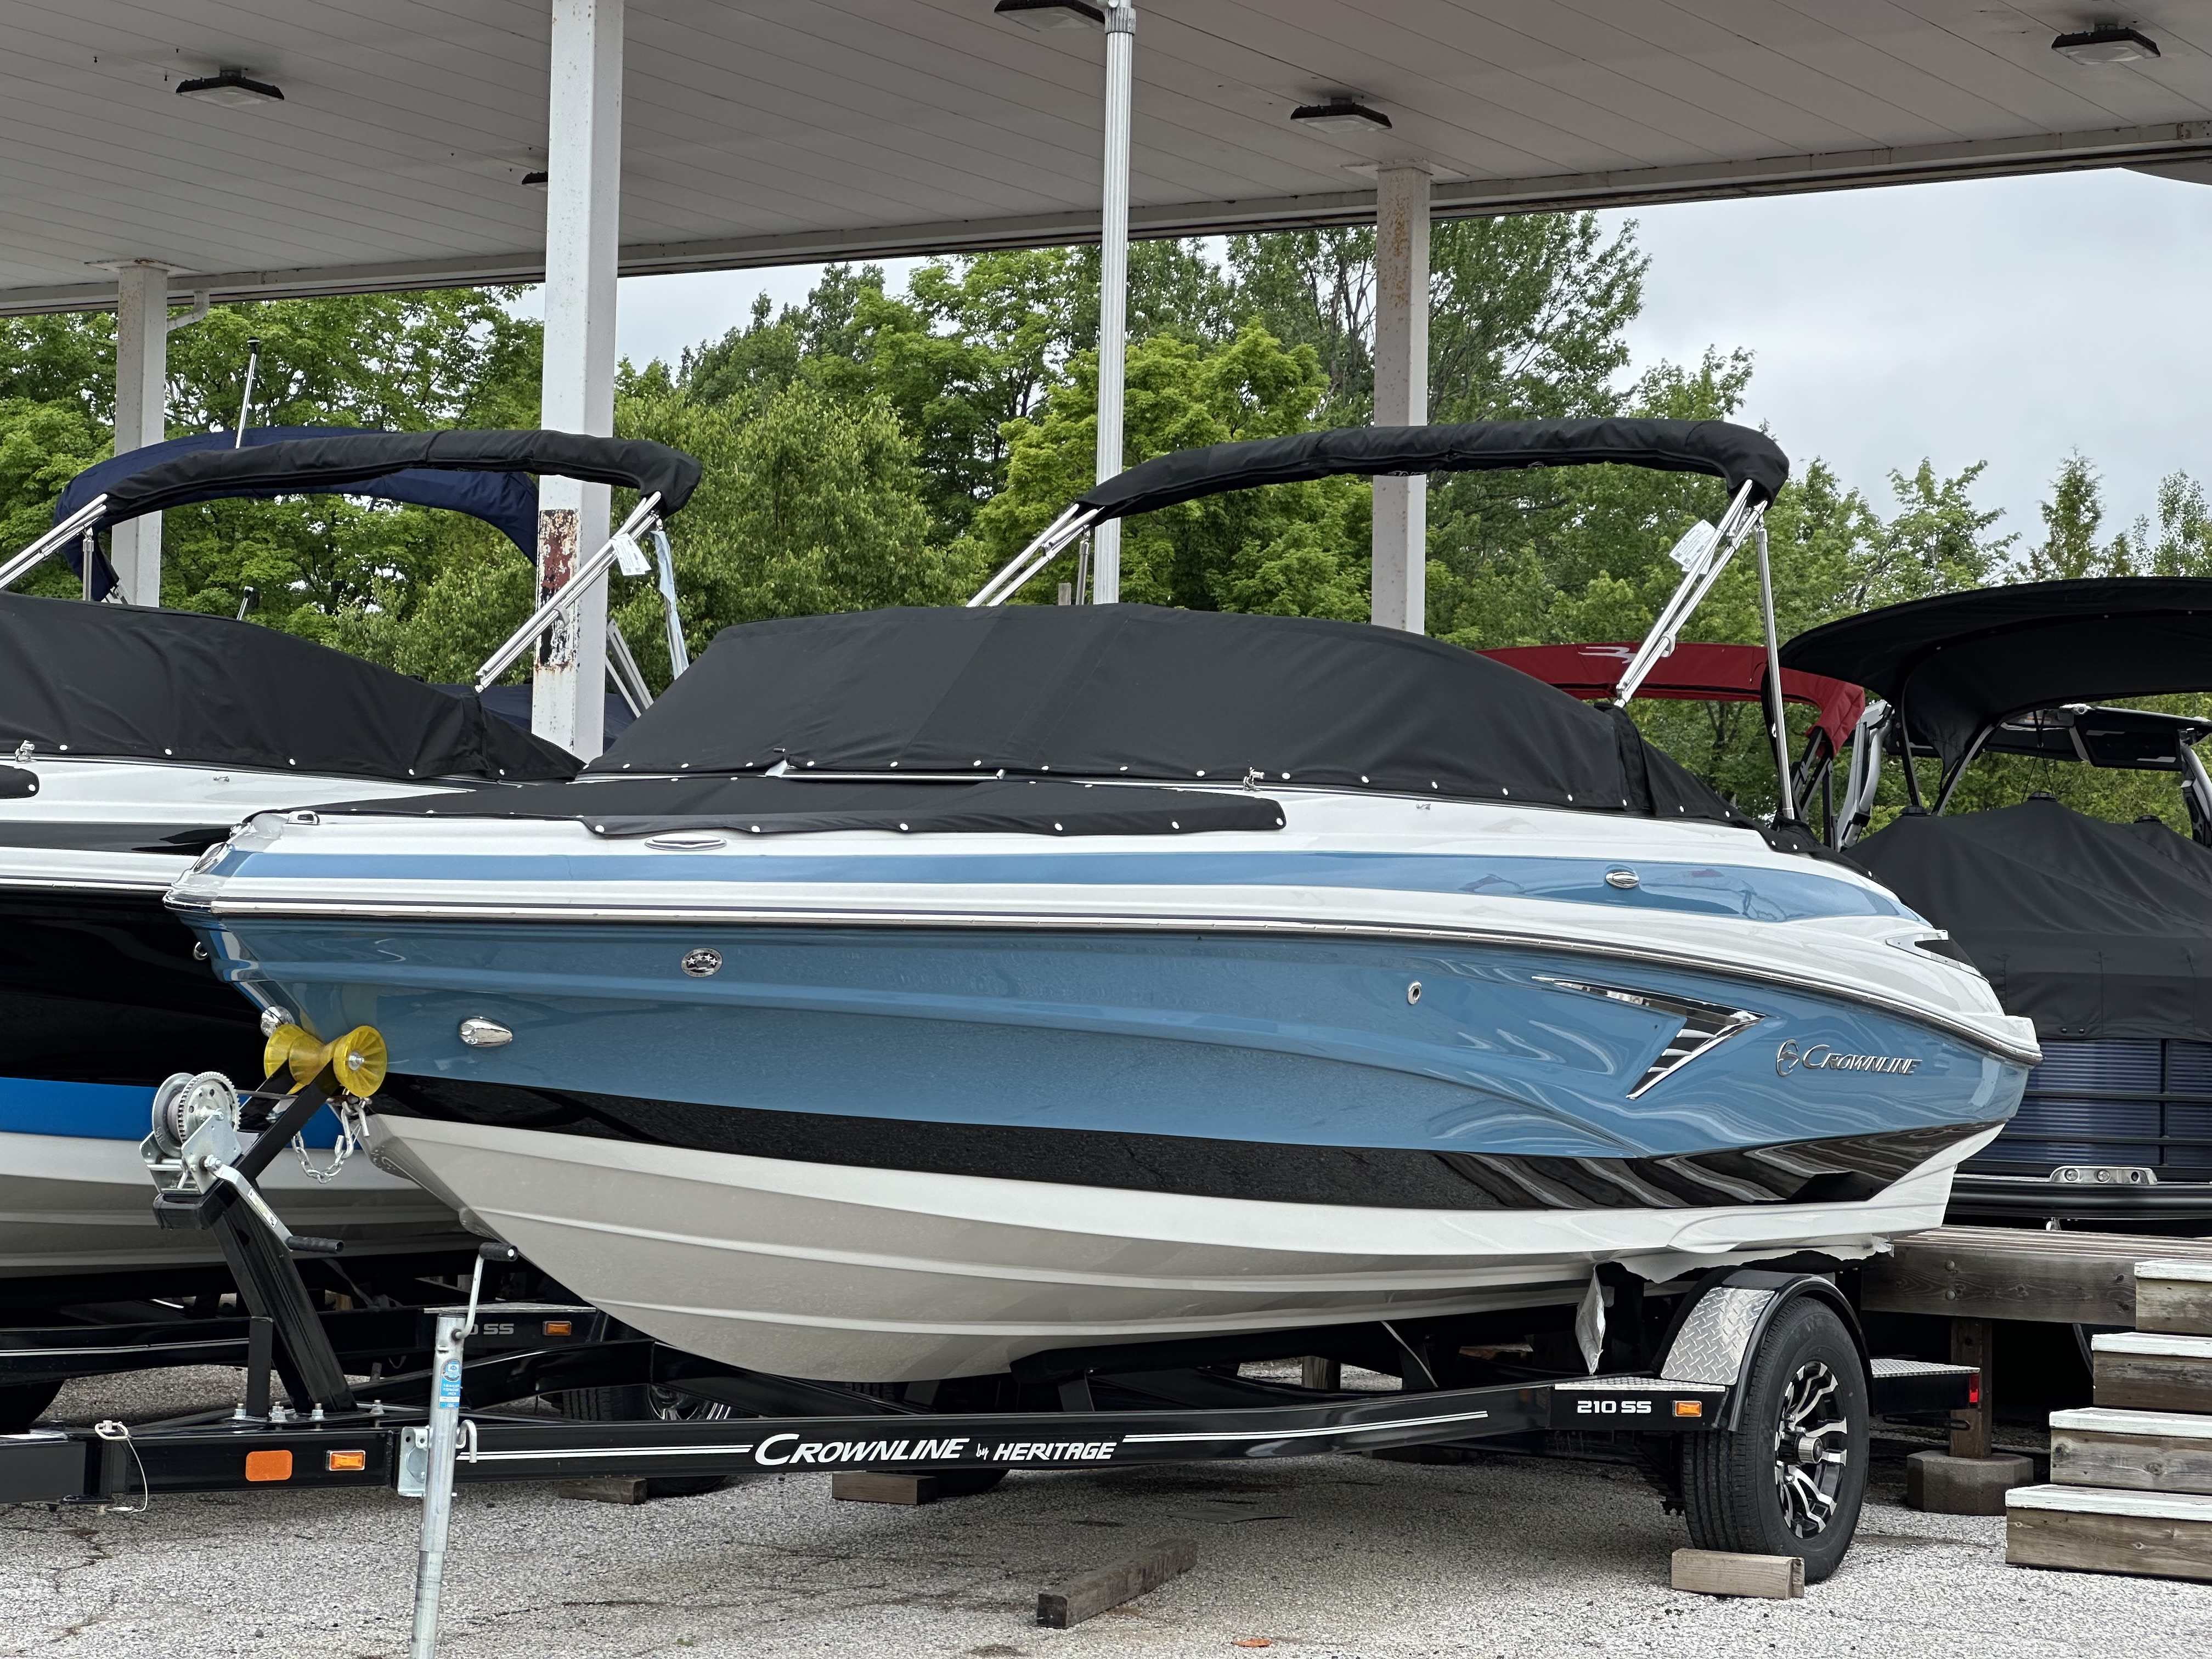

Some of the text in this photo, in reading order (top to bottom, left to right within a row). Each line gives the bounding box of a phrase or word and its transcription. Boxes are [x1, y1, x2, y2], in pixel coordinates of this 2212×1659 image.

[1802, 1043, 1923, 1075] CROWNLINE
[483, 1323, 515, 1335] SS
[1577, 1401, 1652, 1414] 210 SS
[755, 1433, 1118, 1465] CROWNLINE by HERITAGE
